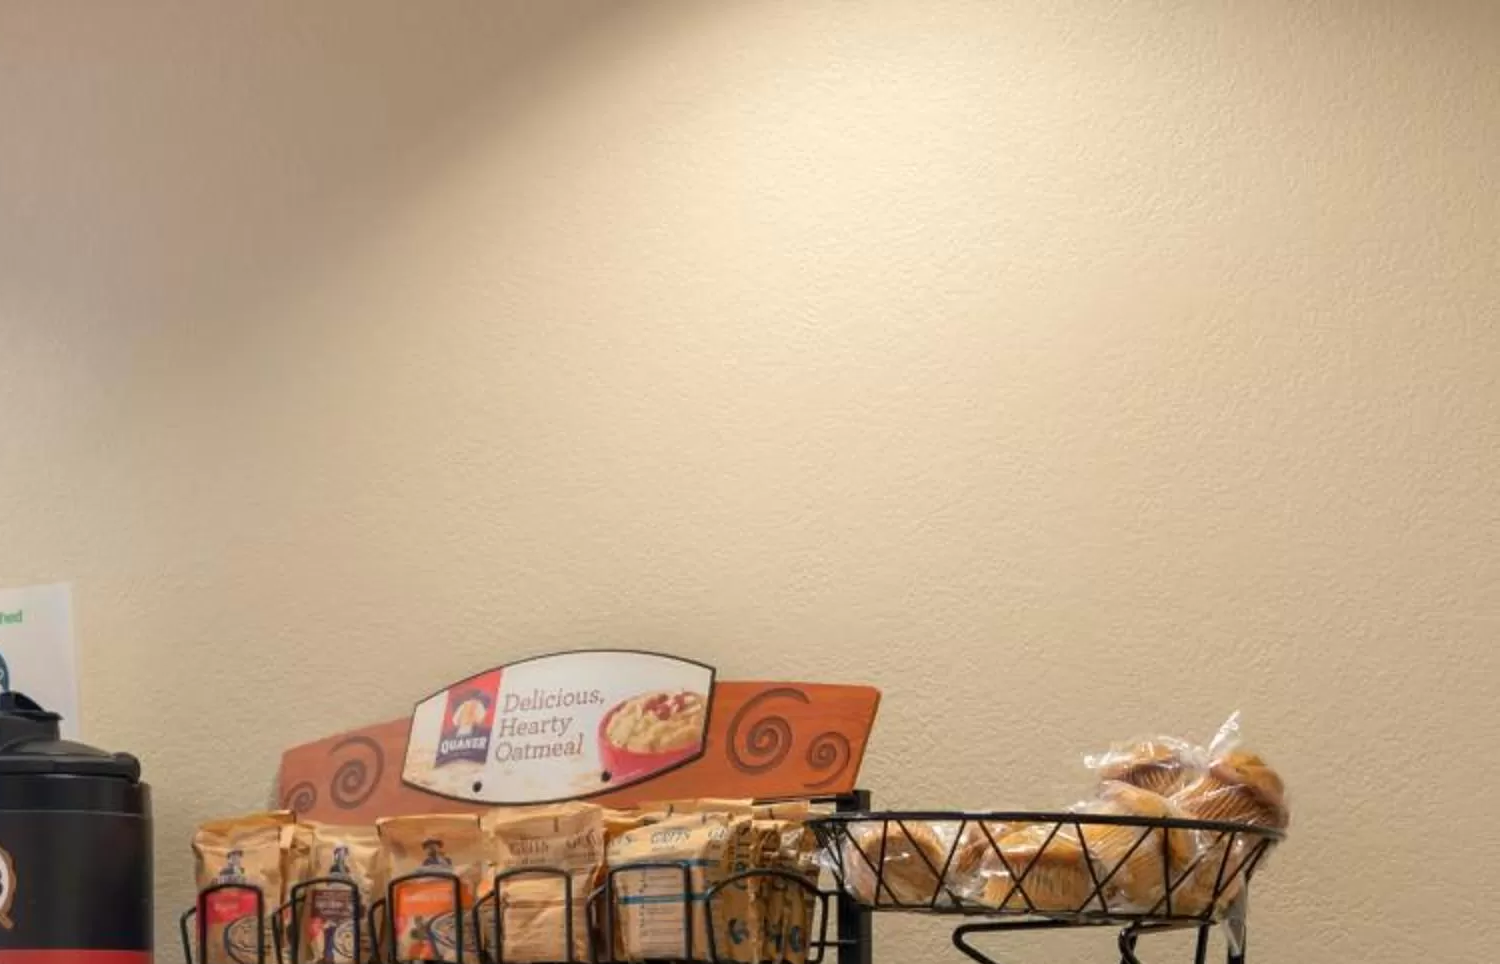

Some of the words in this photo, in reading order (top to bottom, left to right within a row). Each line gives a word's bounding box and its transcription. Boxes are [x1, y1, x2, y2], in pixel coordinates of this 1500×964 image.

[503, 688, 605, 713] Delicious,
[500, 716, 574, 738] Hearty
[495, 732, 585, 762] Oatmeal
